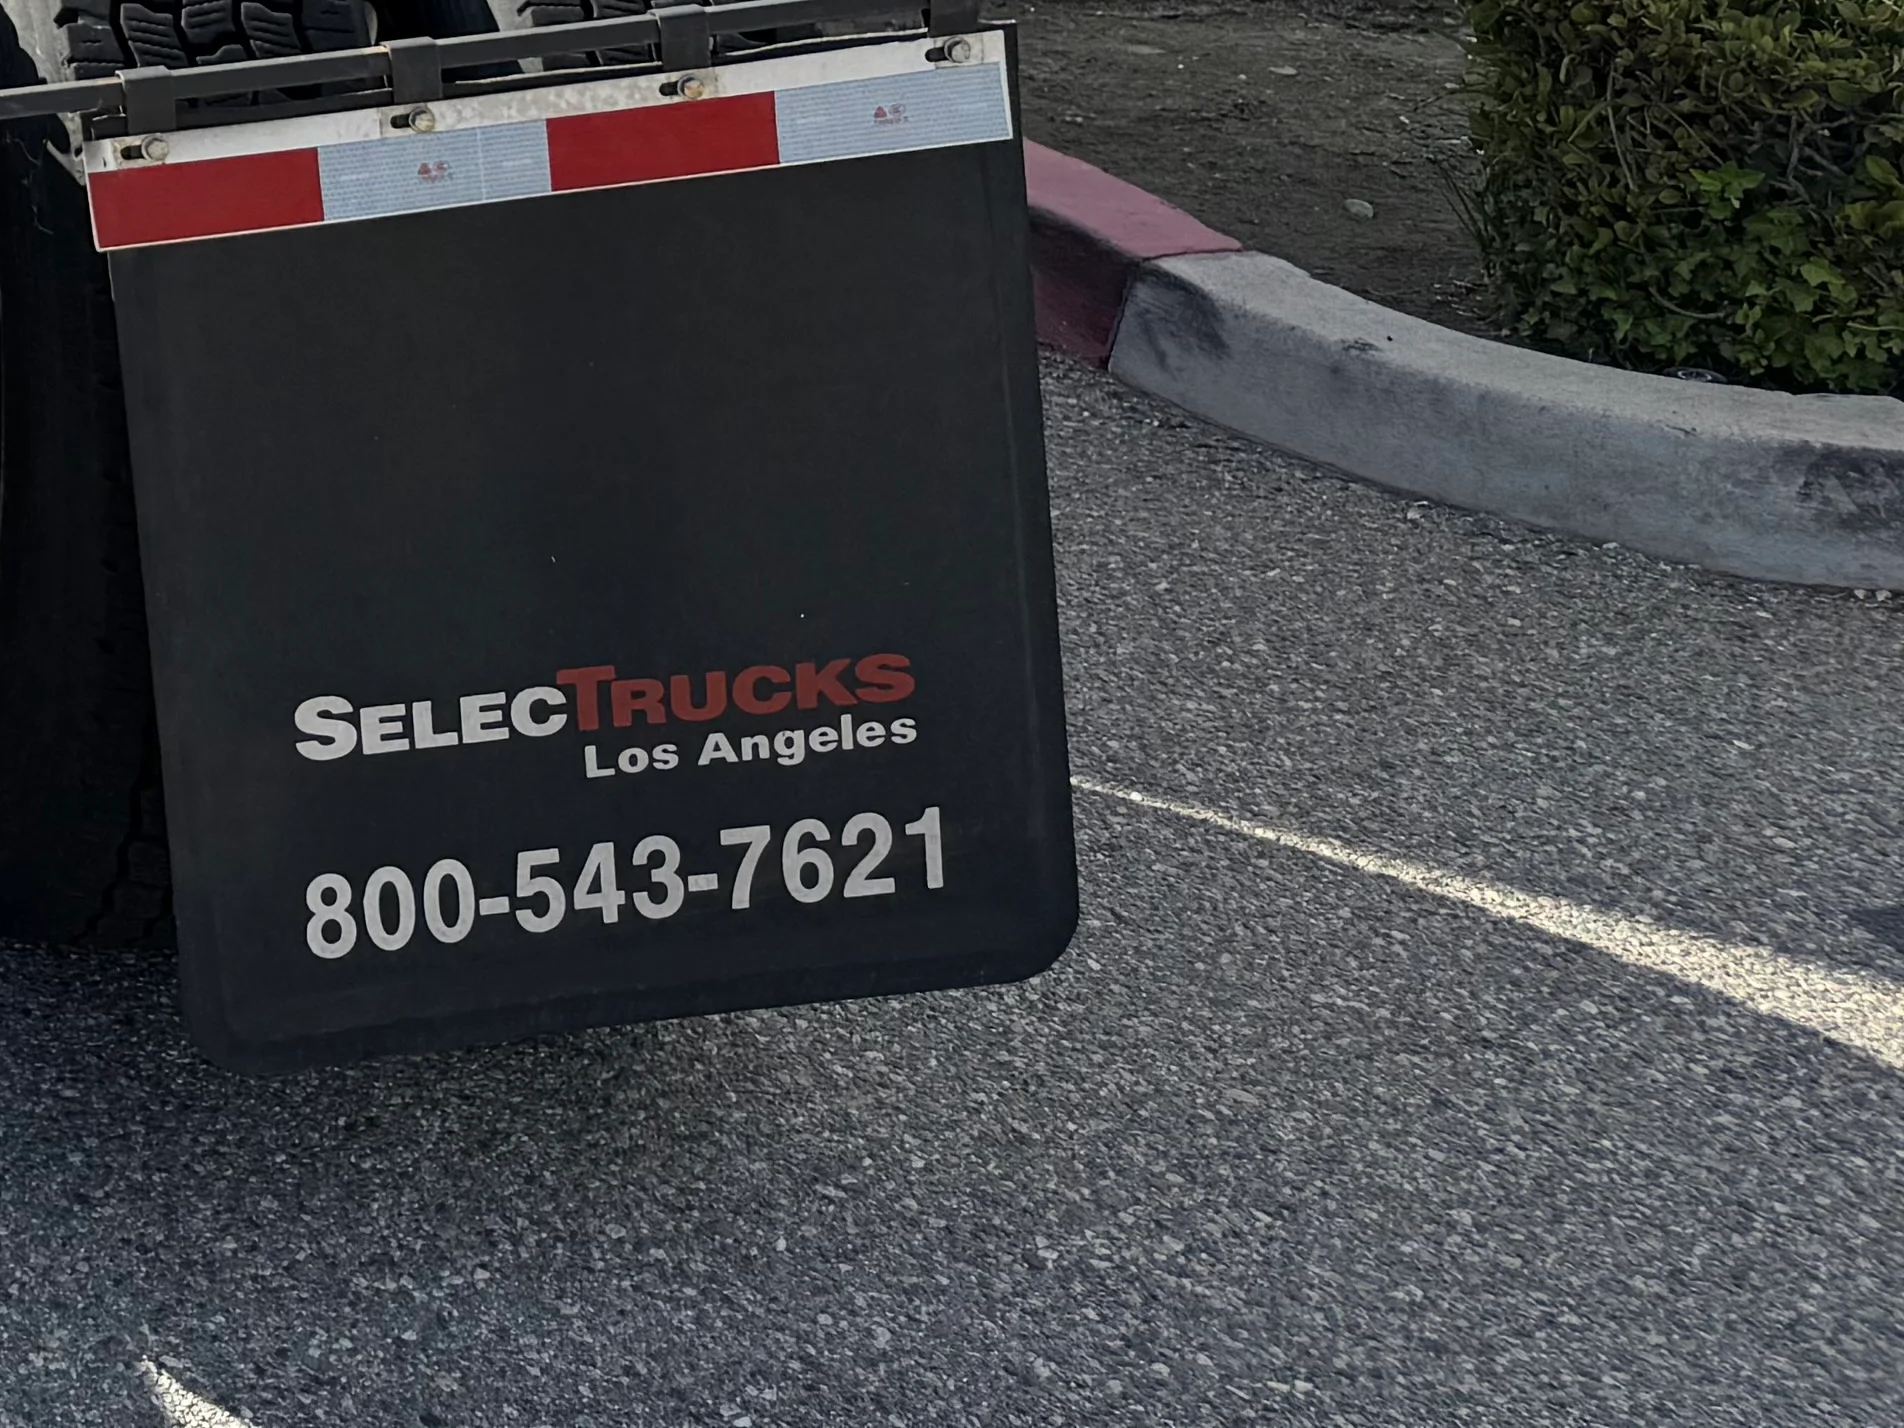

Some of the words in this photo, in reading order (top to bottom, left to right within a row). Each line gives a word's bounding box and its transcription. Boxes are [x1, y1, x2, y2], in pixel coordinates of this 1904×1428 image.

[293, 652, 916, 762] SELECTRUCKS
[583, 739, 680, 779] Los
[697, 713, 918, 767] Angeles
[304, 805, 944, 959] 800-543-7621
